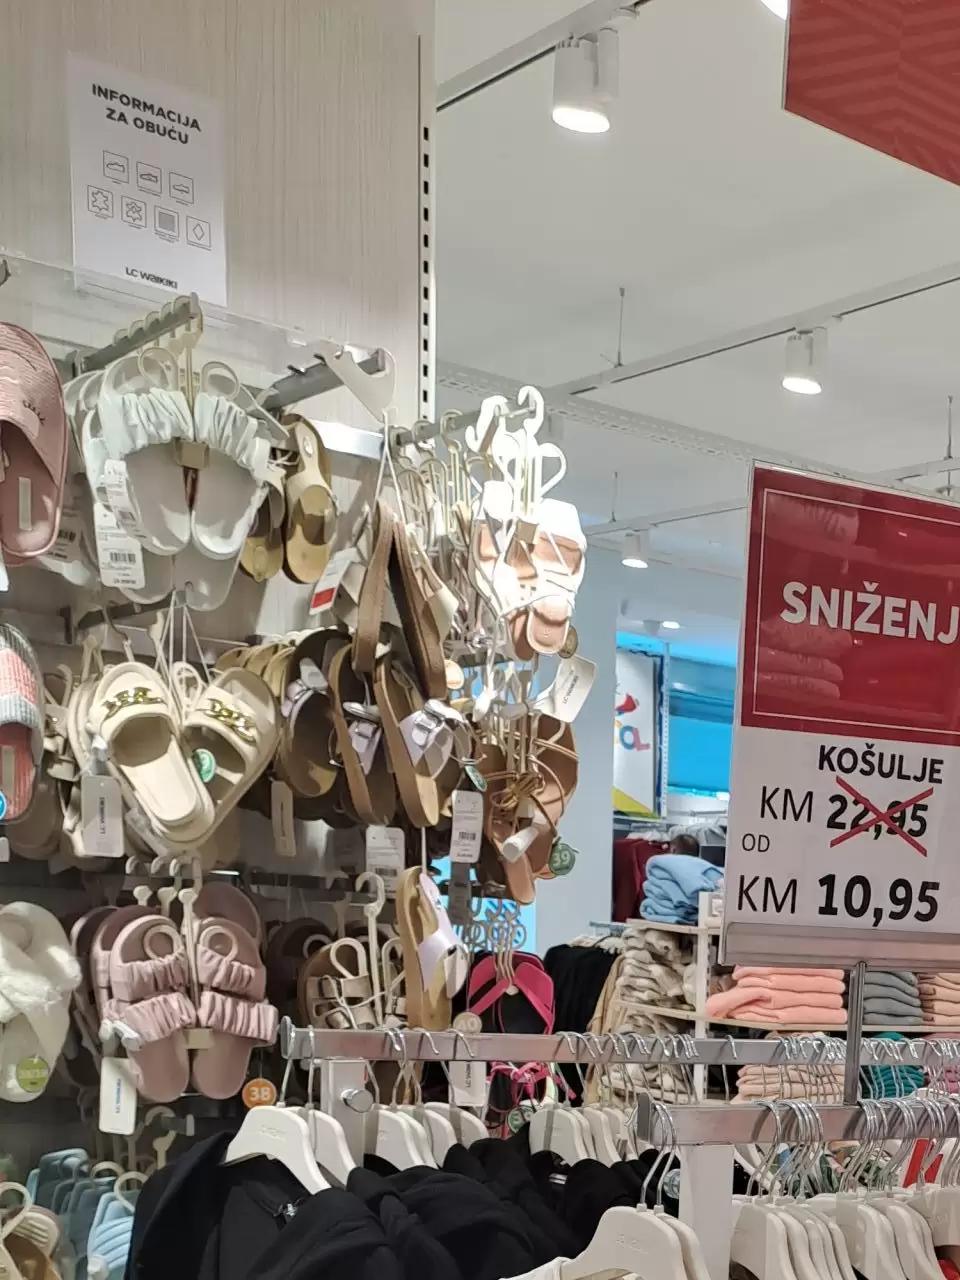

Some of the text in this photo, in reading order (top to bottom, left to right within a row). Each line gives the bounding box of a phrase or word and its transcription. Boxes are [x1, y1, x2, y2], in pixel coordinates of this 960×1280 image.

[92, 84, 201, 132] INFORMACIJA
[106, 108, 189, 144] ZA OBUĆU
[125, 266, 139, 278] LC
[818, 743, 944, 784] KOŠULJE
[760, 785, 929, 840] KM 22,95
[552, 850, 570, 867] 39
[742, 832, 771, 853] OD
[737, 873, 940, 928] KM 10,95
[250, 1086, 268, 1099] 38
